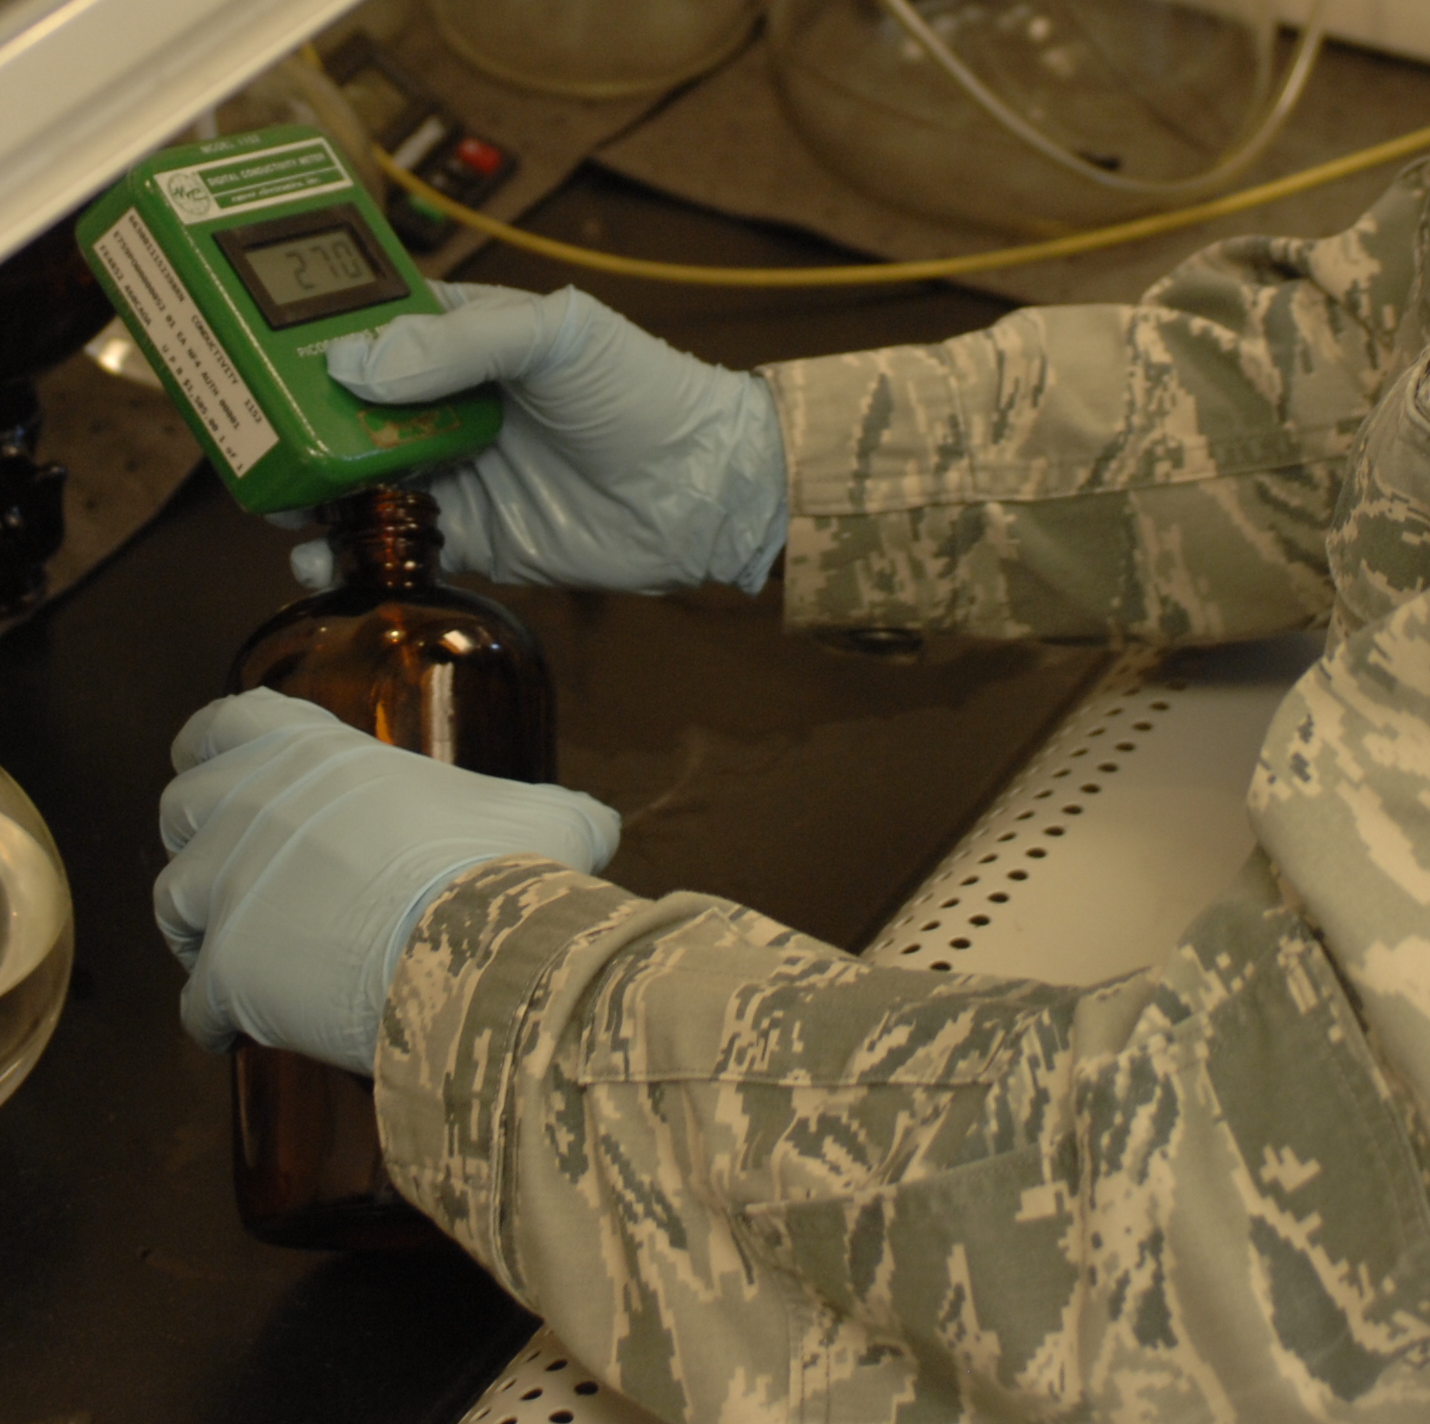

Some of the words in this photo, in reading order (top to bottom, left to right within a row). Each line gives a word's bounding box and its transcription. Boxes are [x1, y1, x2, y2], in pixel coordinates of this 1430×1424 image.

[206, 171, 240, 187] DIGITAL
[239, 157, 297, 179] CONDUCTIVITY
[298, 151, 325, 165] METER
[175, 330, 187, 345] EA
[200, 370, 219, 396] AUTH
[190, 314, 238, 386] CONDUCTIVITY
[243, 398, 262, 424] 1152
[225, 445, 236, 460] of
